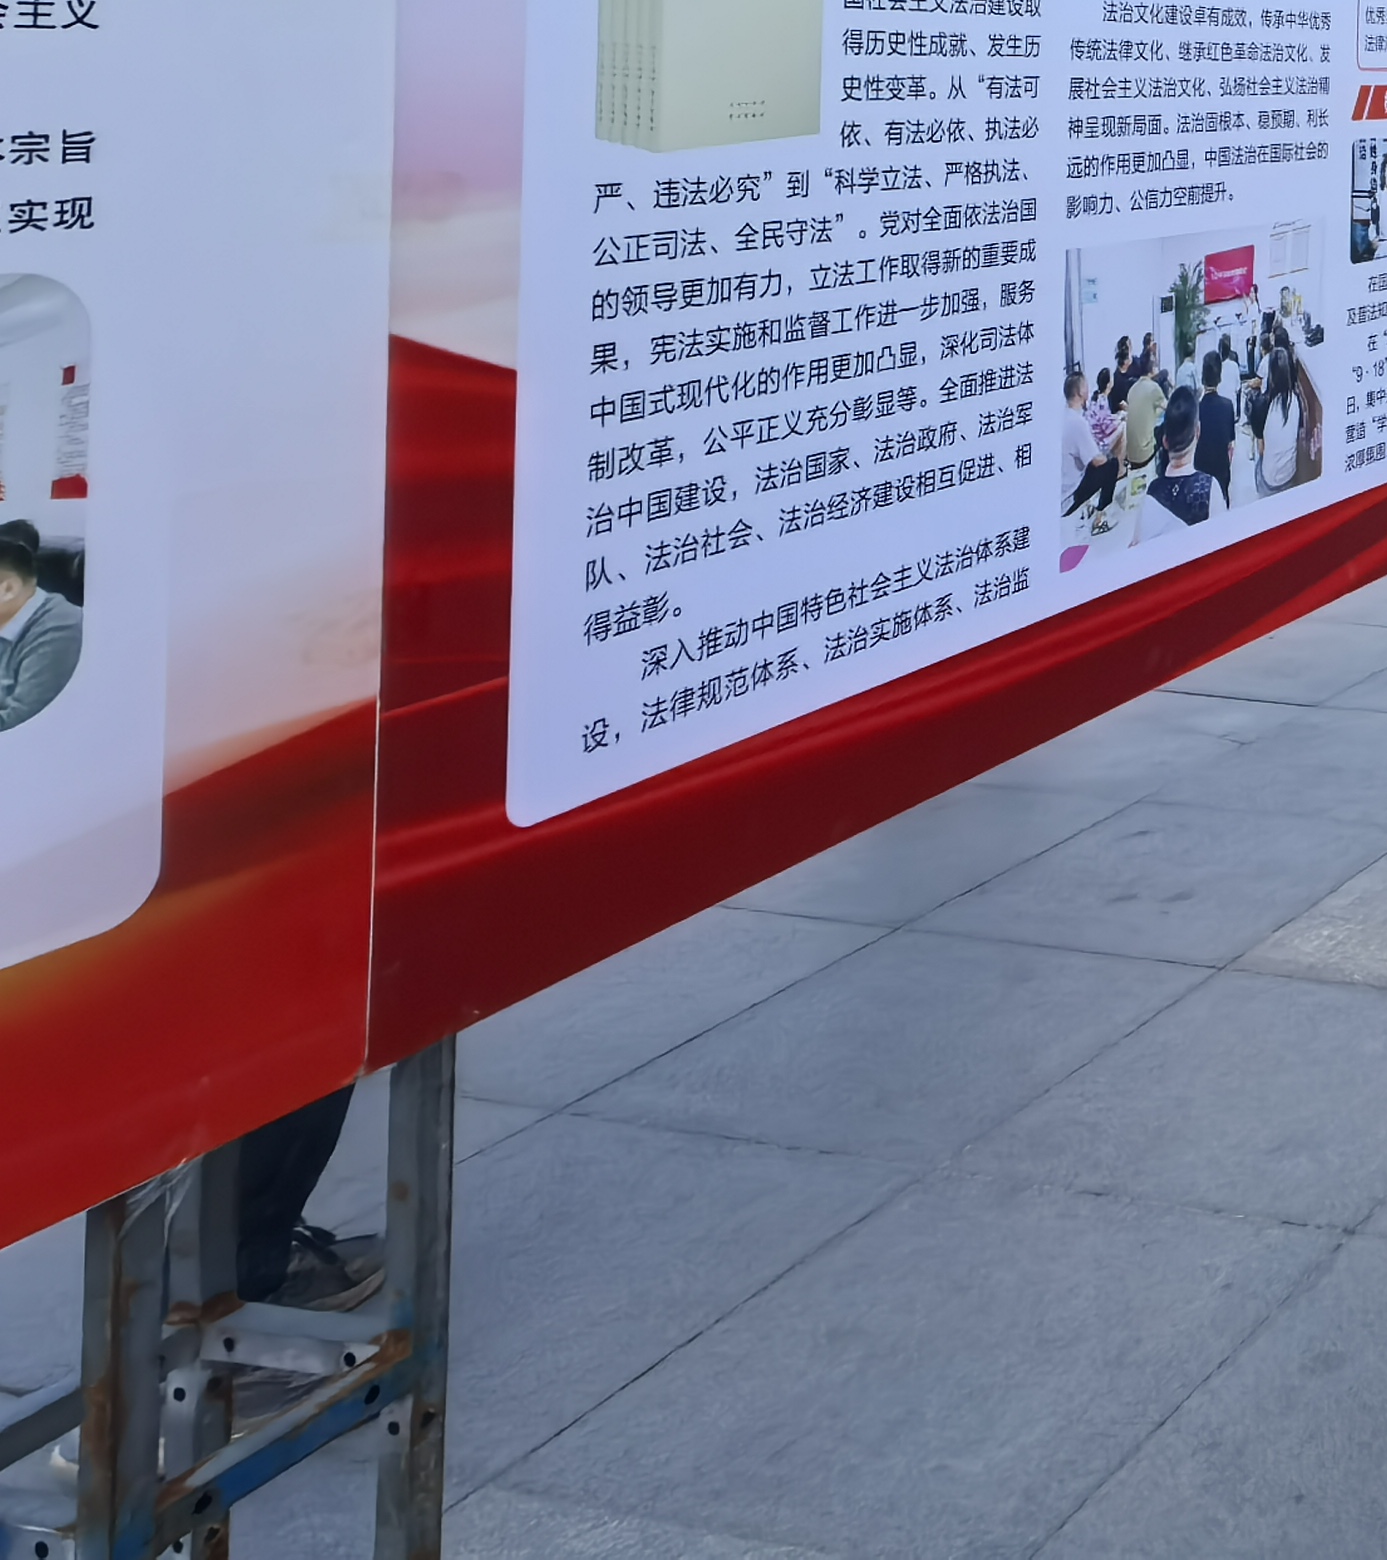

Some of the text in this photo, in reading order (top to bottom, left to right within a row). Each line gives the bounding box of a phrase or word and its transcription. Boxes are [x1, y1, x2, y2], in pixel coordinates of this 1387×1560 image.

[842, 29, 1041, 58] 得历史性成就、发生历
[1102, 0, 1332, 32] 法治文化建设卓有成效，传承中华优秀
[1070, 39, 1331, 64] 传统法律文化、继承红色革命法治文化、发
[1068, 76, 1330, 100] 展社会主义法治文化、弘扬社会主义法治精
[0, 129, 96, 165] 宗旨
[840, 116, 1039, 148] 依、有法必依、执法必
[1066, 141, 1328, 179] 远的作用更加凸显，中国法治在国际社会的
[1066, 181, 1235, 219] 影响力、公信力空前提升。
[591, 239, 1036, 322] 的领导更加有力，立法工作取得新的重要成
[590, 280, 1036, 376] 果，宪法实施和监督工作进一步加强，服务
[590, 321, 1035, 429] 中国式现代化的作用更加凸显，深化司法体
[587, 362, 1034, 483] 制改革，公平正义充分彰显等。全面推进法
[586, 402, 1033, 537] 治中国建设，法治国家、法治政府、法治军
[585, 443, 1032, 592] 队、法治社会、法治经济建设相互促进、相
[583, 591, 683, 646] 得益彰。
[640, 525, 1031, 681] 深入推动中国特色社会主义法治体系建
[581, 567, 1030, 754] 设，法律规范体系、法治实施体系、法治监
